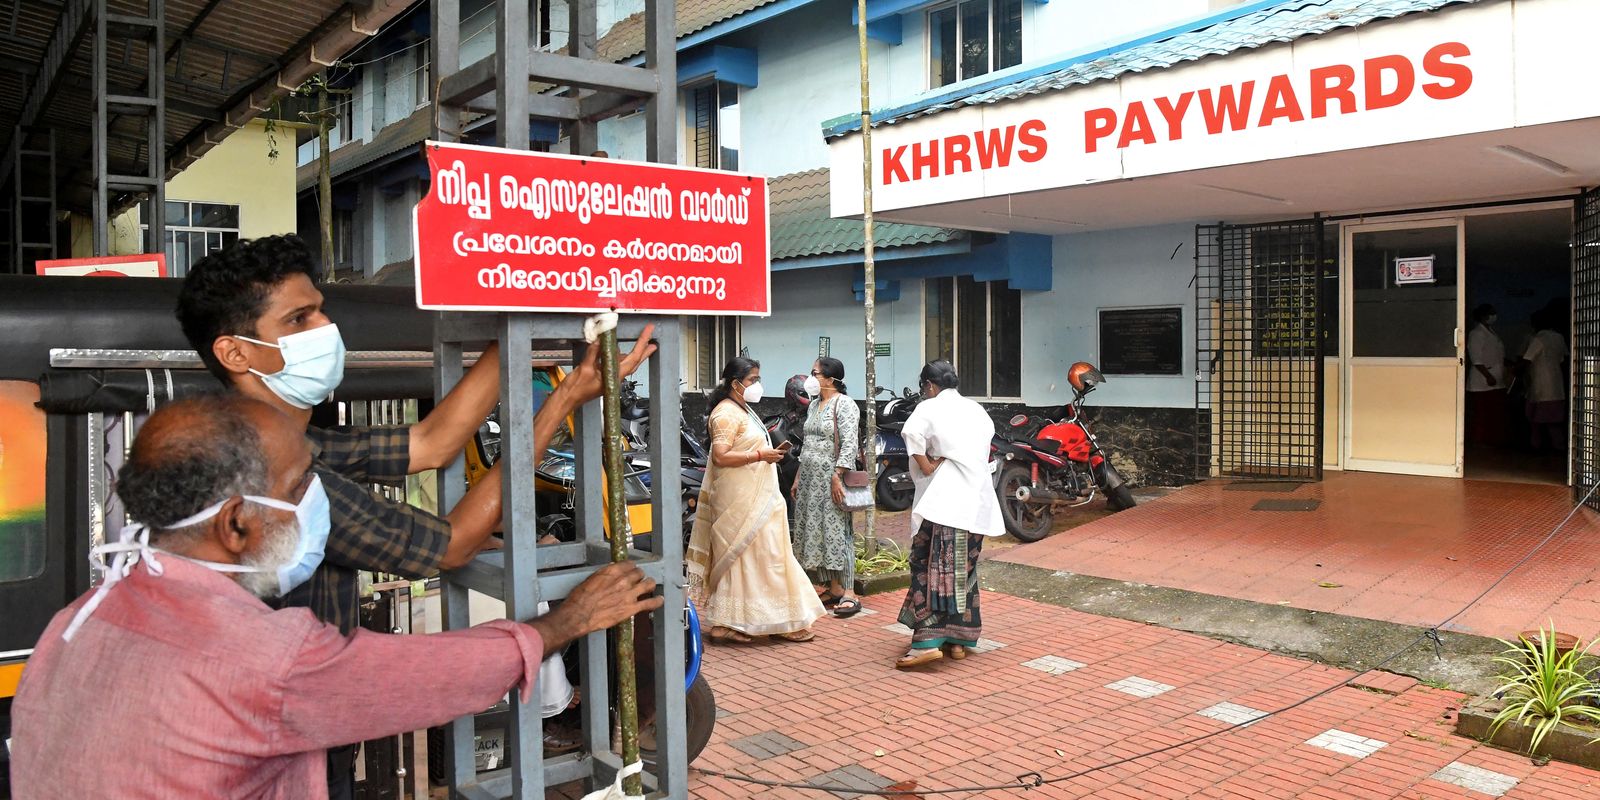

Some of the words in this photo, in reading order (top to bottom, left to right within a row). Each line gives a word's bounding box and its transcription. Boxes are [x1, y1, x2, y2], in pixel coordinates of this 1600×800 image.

[882, 119, 1048, 186] KHRWS
[1084, 41, 1473, 154] PAYWARDS
[437, 159, 492, 220] നിപ്പ
[500, 174, 672, 225] ഐസുലേഷൻ
[679, 186, 752, 226] വാർഡ്
[452, 231, 596, 258] പ്രവേശനം
[602, 237, 743, 265] കർശനമായി
[477, 262, 727, 301] നിരോധിച്ചിരിക്കുന്നു
[819, 337, 827, 358] ARKING
[475, 739, 499, 751] ACK
